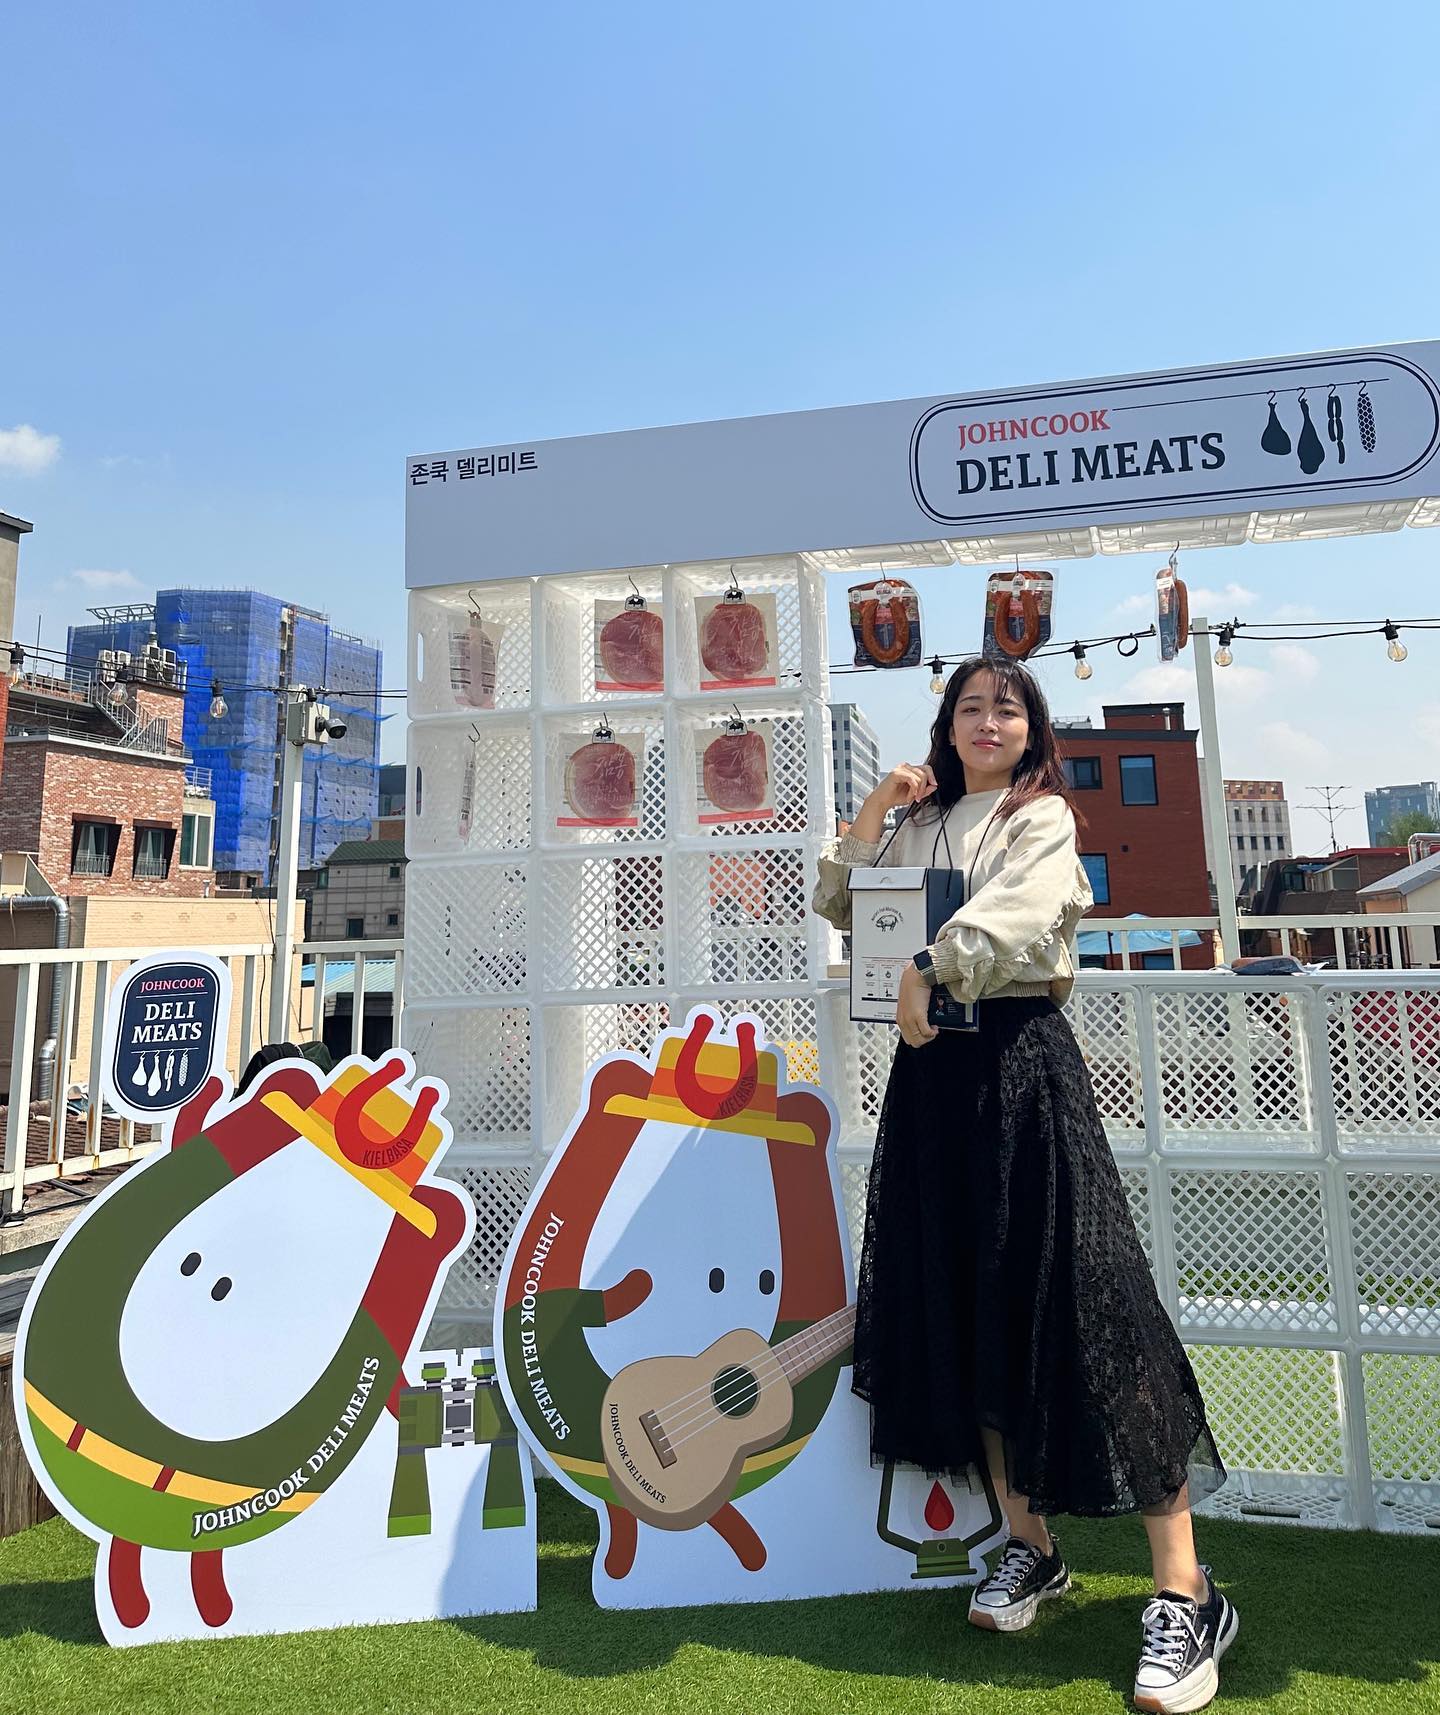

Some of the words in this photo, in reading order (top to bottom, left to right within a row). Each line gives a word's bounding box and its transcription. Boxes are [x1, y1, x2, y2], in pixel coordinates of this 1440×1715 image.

[958, 408, 1111, 450] JOHNCOOK
[410, 460, 449, 485] 존쿡
[457, 452, 538, 480] 델리미트
[956, 450, 1060, 495] DELI
[1071, 432, 1226, 483] MEATS
[140, 978, 206, 993] JOHNCOOK
[131, 1022, 203, 1044] MEATS
[144, 1001, 196, 1021] DELI
[362, 1138, 414, 1166] KIELBASA
[520, 1212, 565, 1325] JOHNCOOK
[520, 1329, 542, 1378] DELI
[530, 1377, 571, 1441] MEATS
[193, 1467, 310, 1537] JOHNCOOK
[306, 1425, 348, 1474] DELI
[340, 1356, 380, 1429] MEATS
[609, 1403, 630, 1460] JOHNCOOK
[625, 1459, 642, 1482] DELI
[639, 1478, 667, 1504] MEATS
